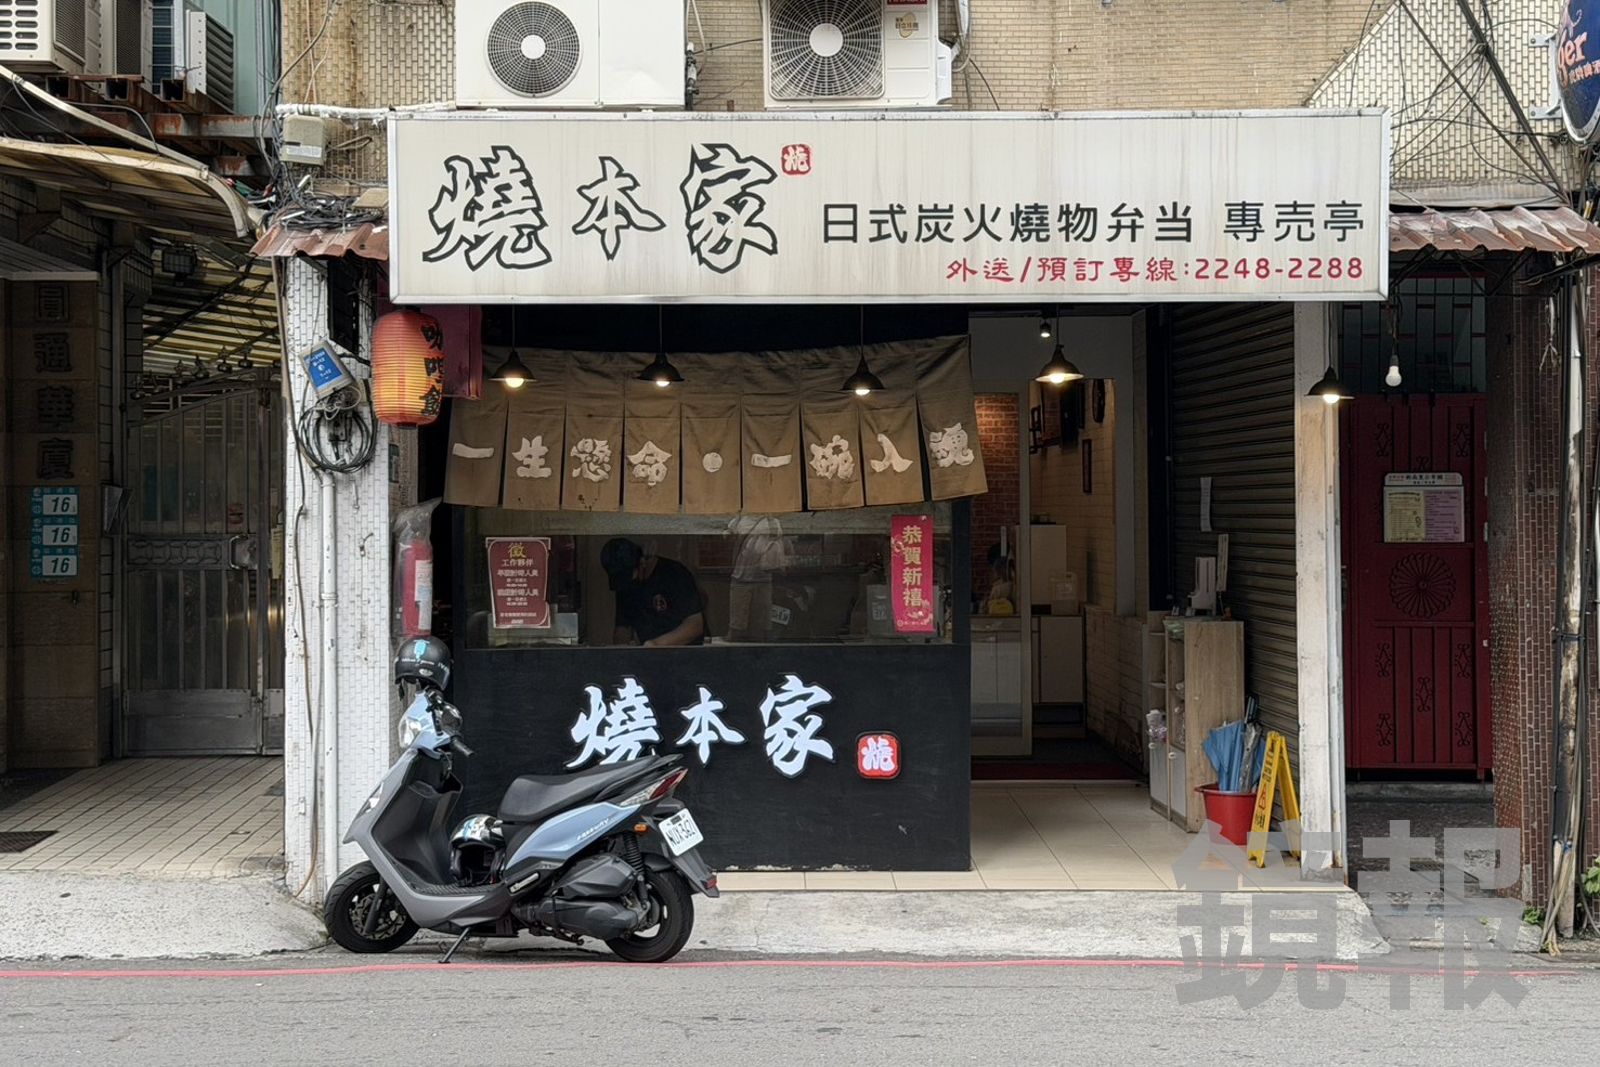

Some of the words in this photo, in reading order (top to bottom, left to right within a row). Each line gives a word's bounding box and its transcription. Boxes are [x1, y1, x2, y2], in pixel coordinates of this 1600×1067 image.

[422, 143, 778, 274] 燒本家
[823, 201, 1193, 244] 日式炭火燒物弁当
[51, 496, 71, 513] 16
[51, 527, 71, 543] 16
[51, 557, 71, 574] 16
[902, 524, 922, 607] 恭賀新禧
[564, 674, 834, 777] 燒本家
